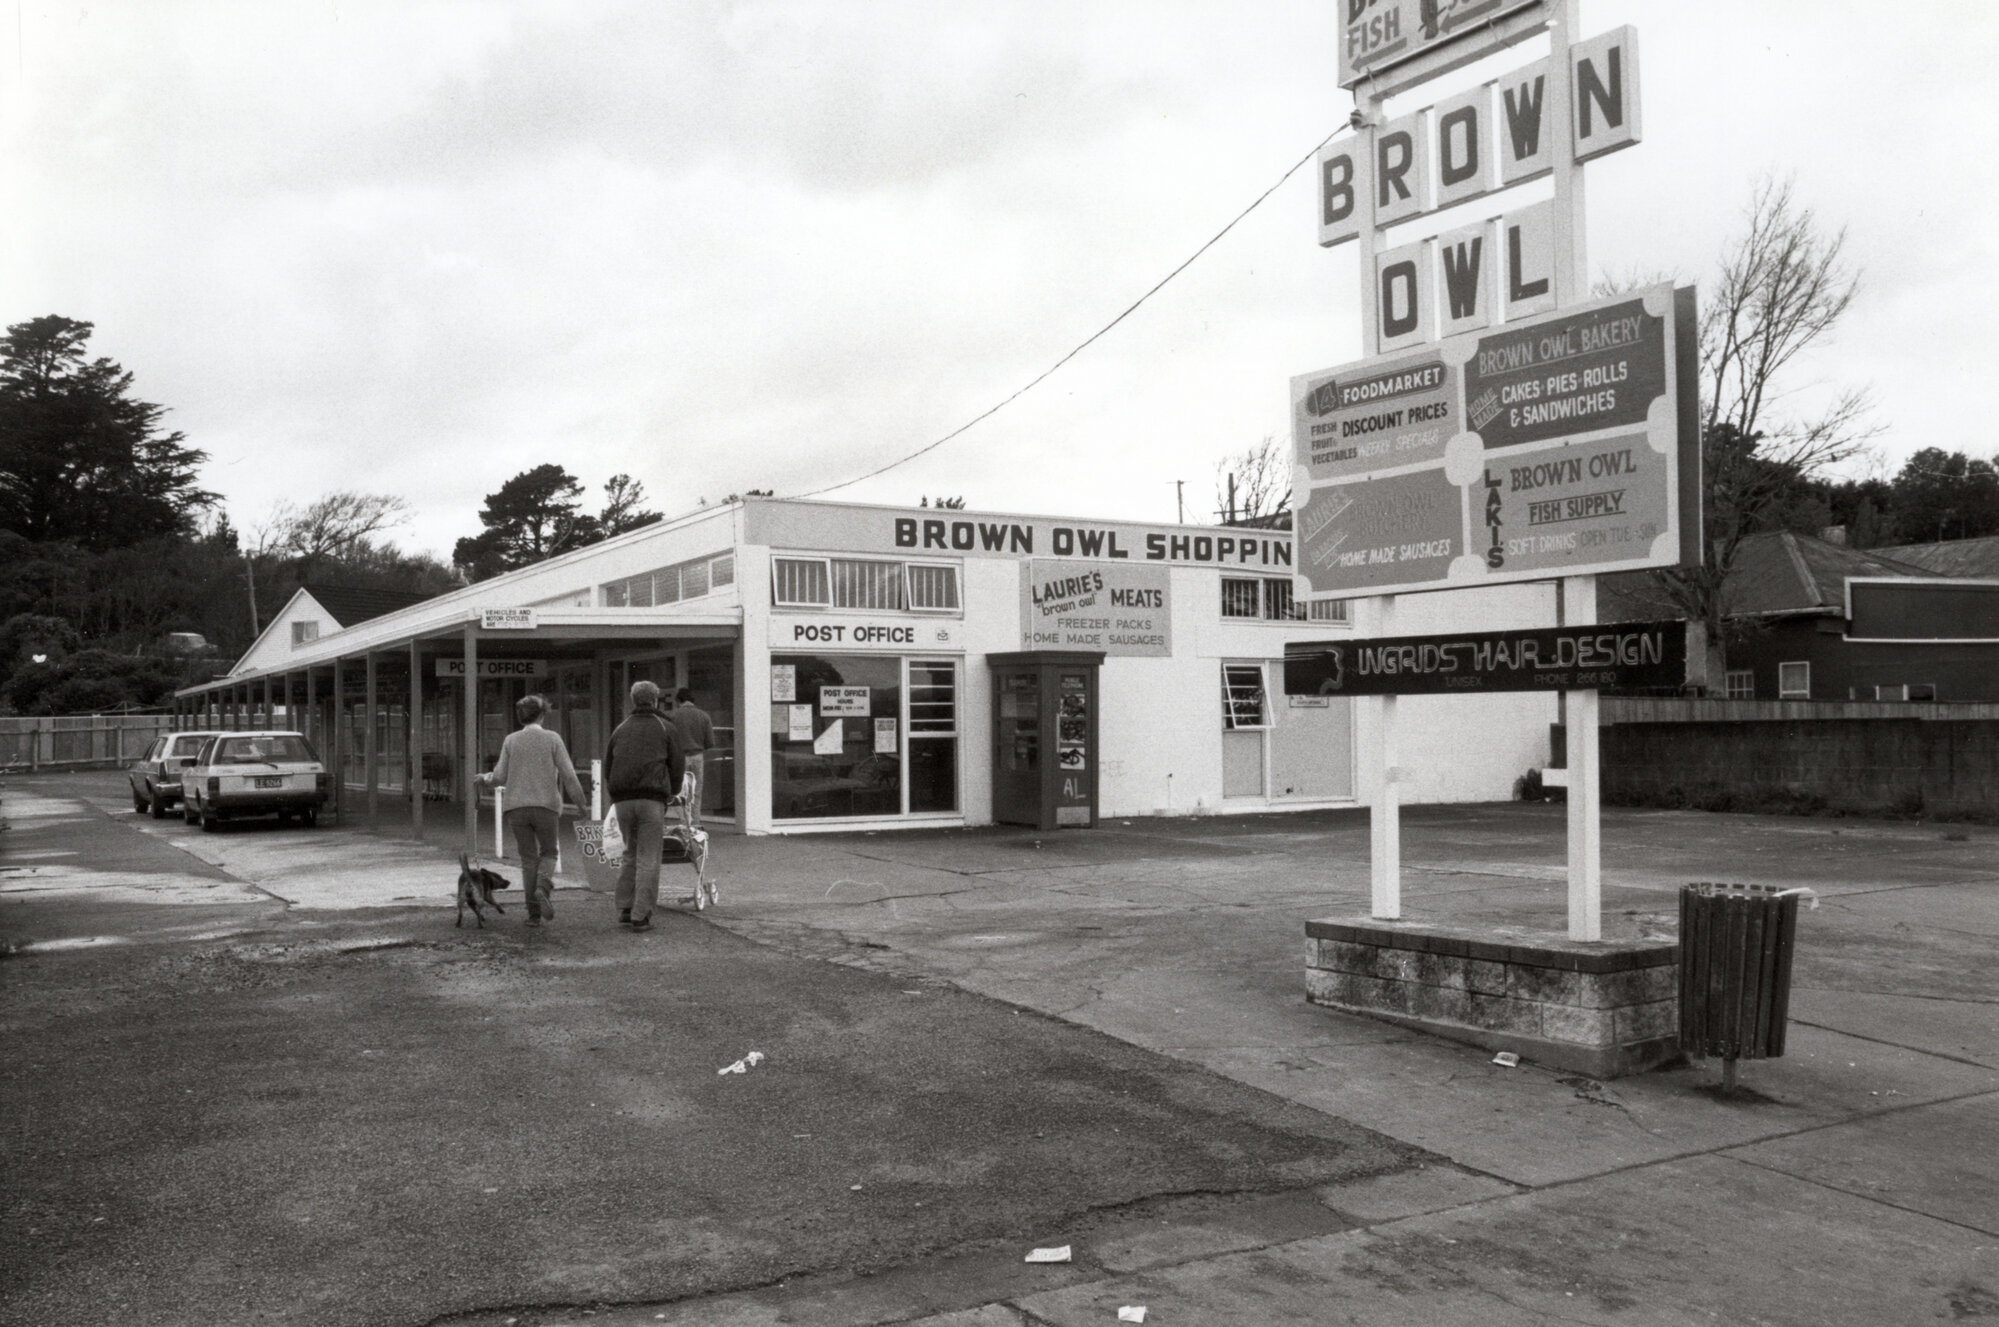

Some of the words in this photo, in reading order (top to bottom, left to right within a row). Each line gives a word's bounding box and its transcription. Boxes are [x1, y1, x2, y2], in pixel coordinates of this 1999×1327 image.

[1348, 7, 1399, 58] FISH
[1323, 46, 1623, 226] BROWN
[1382, 225, 1548, 338] OWL
[1479, 342, 1533, 374] BROWN
[1540, 332, 1577, 359] OWL
[1581, 315, 1643, 351] BAKERY
[1343, 367, 1441, 403] FOODMARKET
[1502, 380, 1540, 404] CAKES
[1547, 372, 1577, 395] PIES
[1584, 361, 1628, 387] ROLLS
[1467, 387, 1498, 416] HOME
[1510, 408, 1520, 427] &
[1523, 390, 1616, 425] SANDWICHES
[1311, 422, 1337, 436] FRESH
[1342, 411, 1403, 437] DISCOUNT
[1408, 402, 1448, 424] PRICES
[1312, 437, 1332, 450] FRUIT
[1312, 448, 1357, 465] VEGETABLES
[1511, 458, 1582, 492] BROWN
[1589, 450, 1636, 478] OWL
[1529, 502, 1561, 522] FISH
[1567, 491, 1624, 518] SUPPLY
[895, 518, 1033, 554] BROWN
[1052, 527, 1128, 558] OWL
[1146, 533, 1292, 566] SHOPPIN
[1340, 550, 1368, 567] HOME
[1368, 546, 1397, 564] MADE
[1400, 538, 1451, 561] SAUSAGES
[1508, 536, 1536, 555] SOFT
[1540, 532, 1576, 551] DRINKS
[1580, 530, 1606, 547] OPEN
[1032, 571, 1103, 604] LAURIE'S
[1111, 588, 1163, 607] MEATS
[794, 624, 846, 642] POST
[853, 626, 914, 643] OFFICE
[1024, 633, 1060, 643] HOME
[1067, 634, 1101, 644] MADE
[1109, 634, 1164, 645] SAUSAGES
[1057, 618, 1110, 629] FREEZER
[1116, 619, 1152, 630] PACKS
[450, 661, 483, 674] POT
[488, 661, 535, 674] OFFICE
[1358, 643, 1459, 675] INGRIDS
[1474, 639, 1541, 671] HAIR
[1556, 632, 1662, 668] DESIGN
[824, 689, 841, 697] POST
[844, 689, 867, 697] OFFICE
[1534, 673, 1569, 685] PHONE
